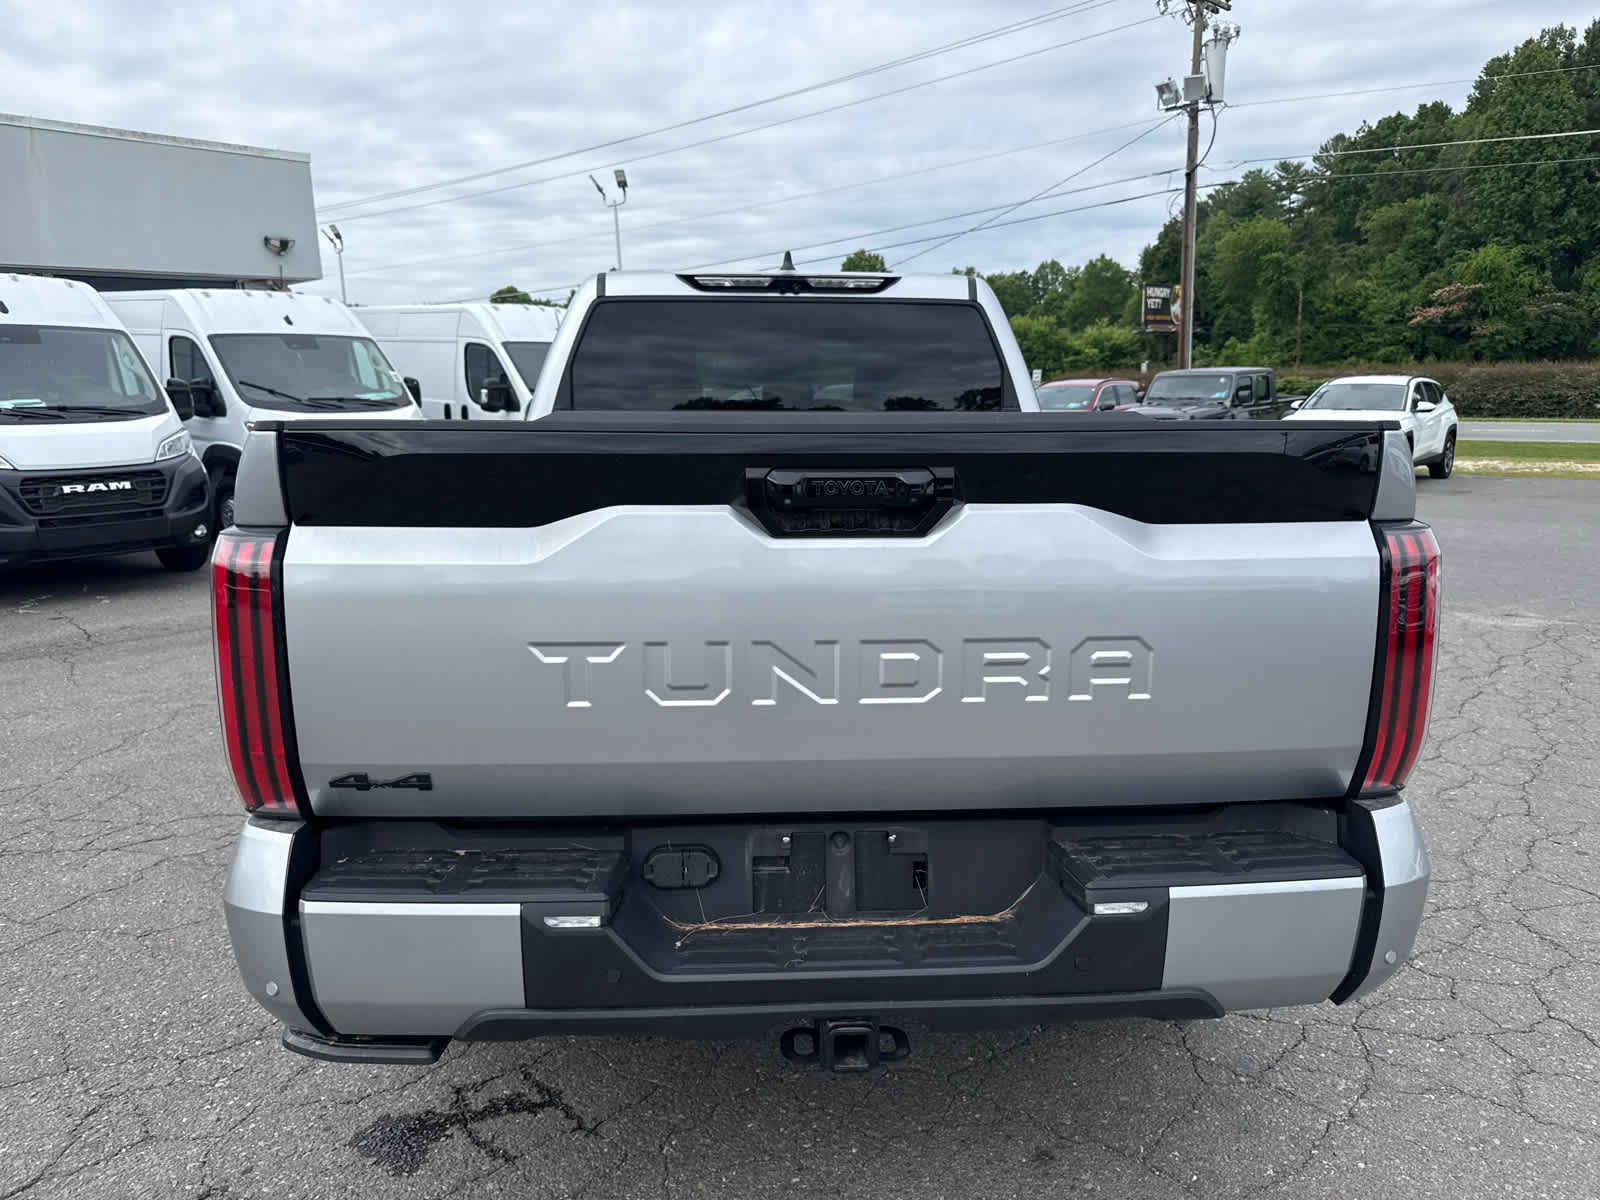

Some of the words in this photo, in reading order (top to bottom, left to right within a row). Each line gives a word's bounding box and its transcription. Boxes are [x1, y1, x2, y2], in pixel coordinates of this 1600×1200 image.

[1146, 287, 1170, 298] HUNGRY
[61, 481, 132, 494] RAM
[812, 480, 889, 496] TOYOTA
[527, 635, 1154, 707] TUNDRA
